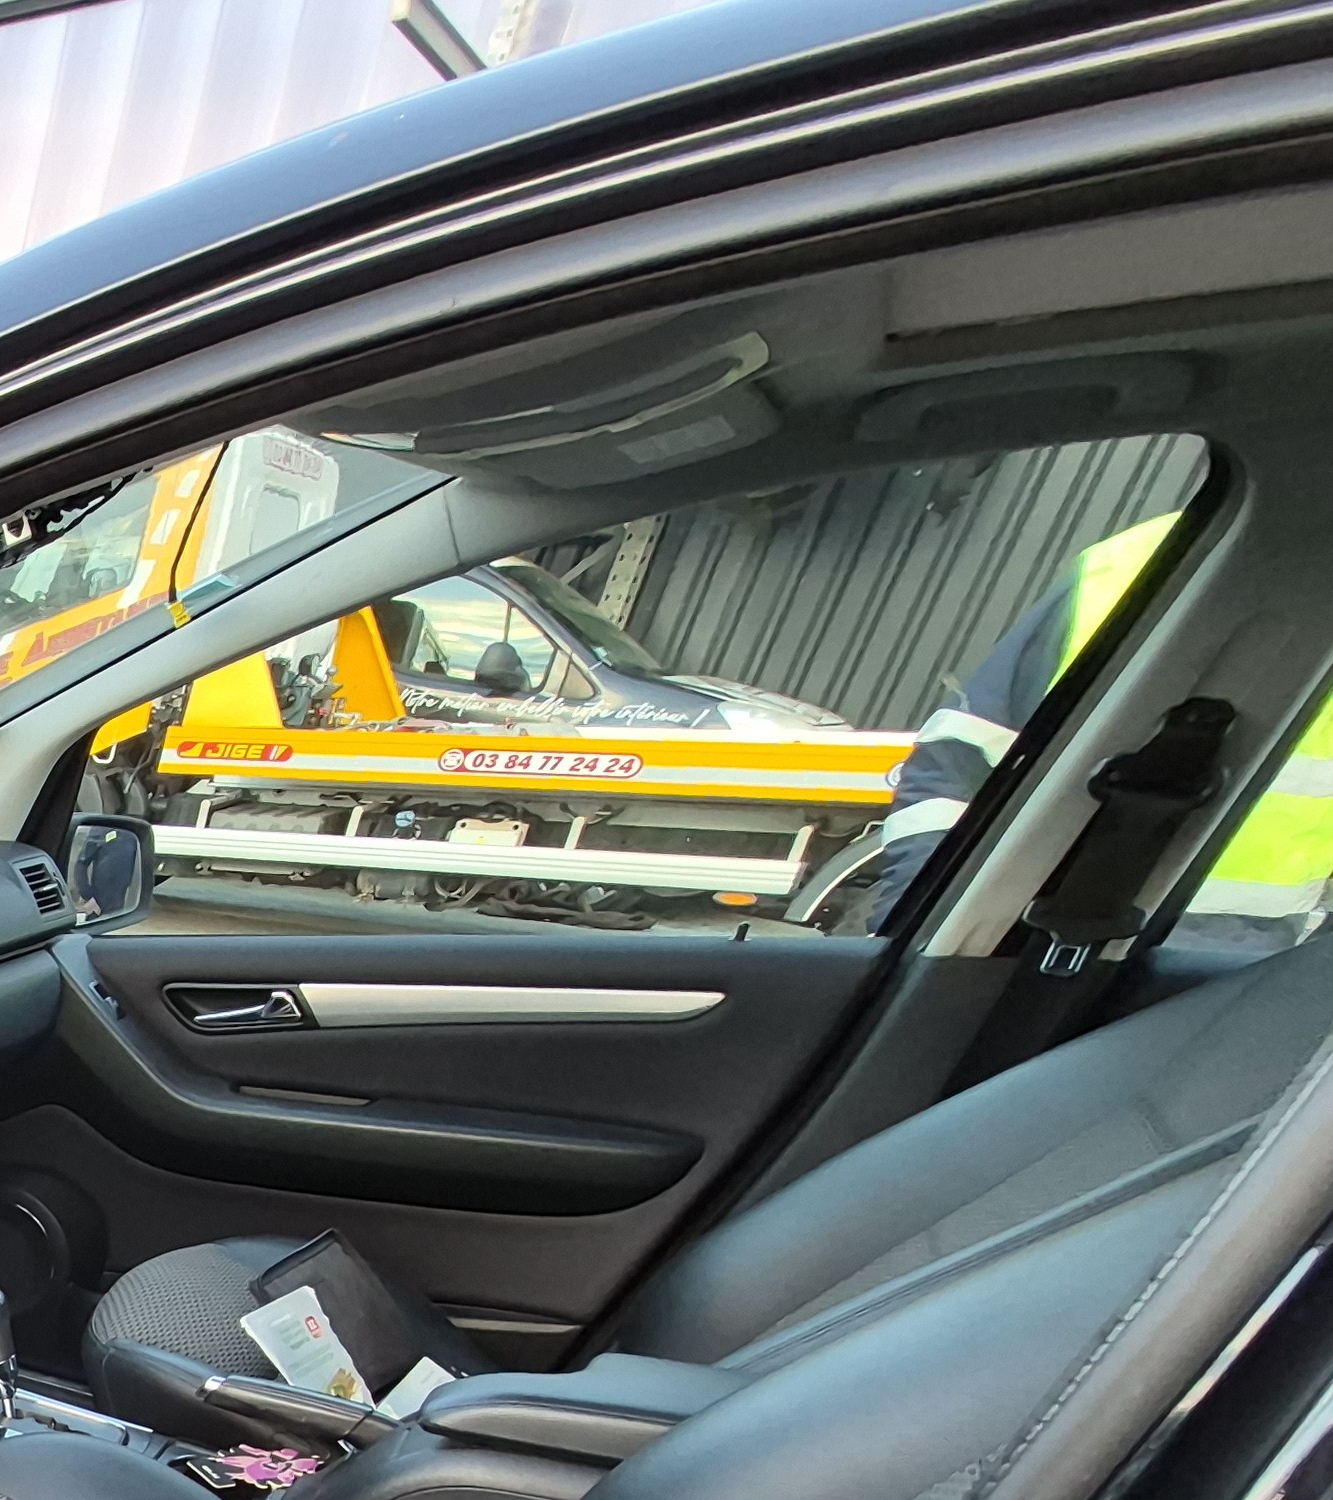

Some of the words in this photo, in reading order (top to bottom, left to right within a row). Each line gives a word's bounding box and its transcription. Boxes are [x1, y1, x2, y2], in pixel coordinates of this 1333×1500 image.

[205, 743, 266, 759] JIGE
[472, 752, 497, 769] 03
[503, 754, 533, 770] 84
[539, 756, 564, 771] 77
[569, 756, 598, 773] 24
[603, 757, 635, 774] 24
